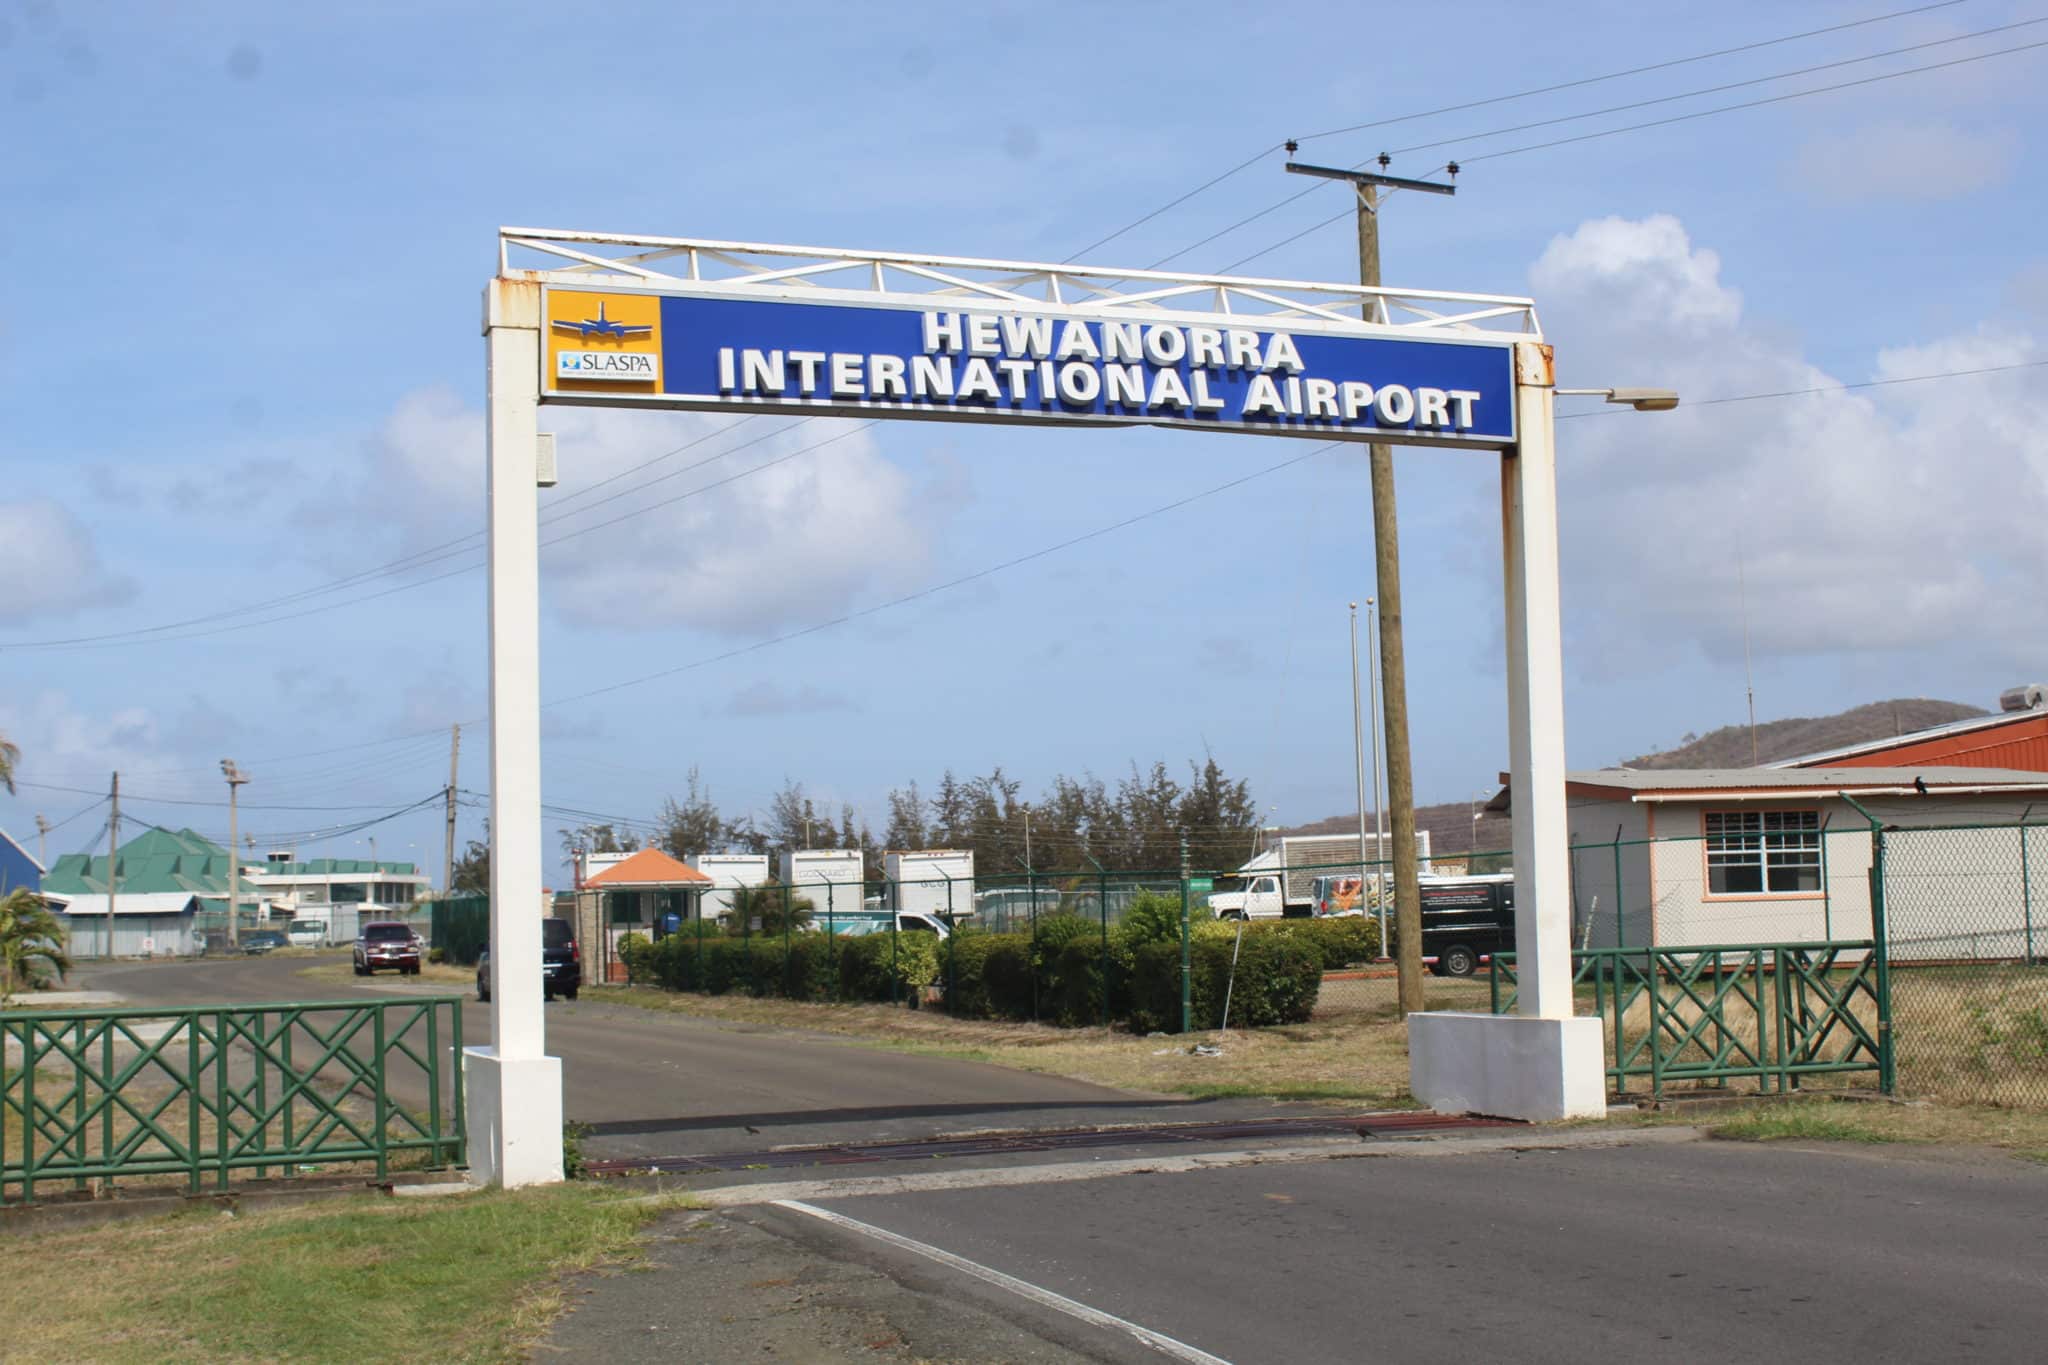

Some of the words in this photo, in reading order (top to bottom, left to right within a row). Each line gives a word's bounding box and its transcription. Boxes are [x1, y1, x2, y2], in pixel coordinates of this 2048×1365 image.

[583, 354, 652, 372] SLASPA
[922, 311, 1304, 372] HEWANORRA
[718, 347, 1225, 411] INTERNATIONAL
[1241, 374, 1480, 428] AIRPORT
